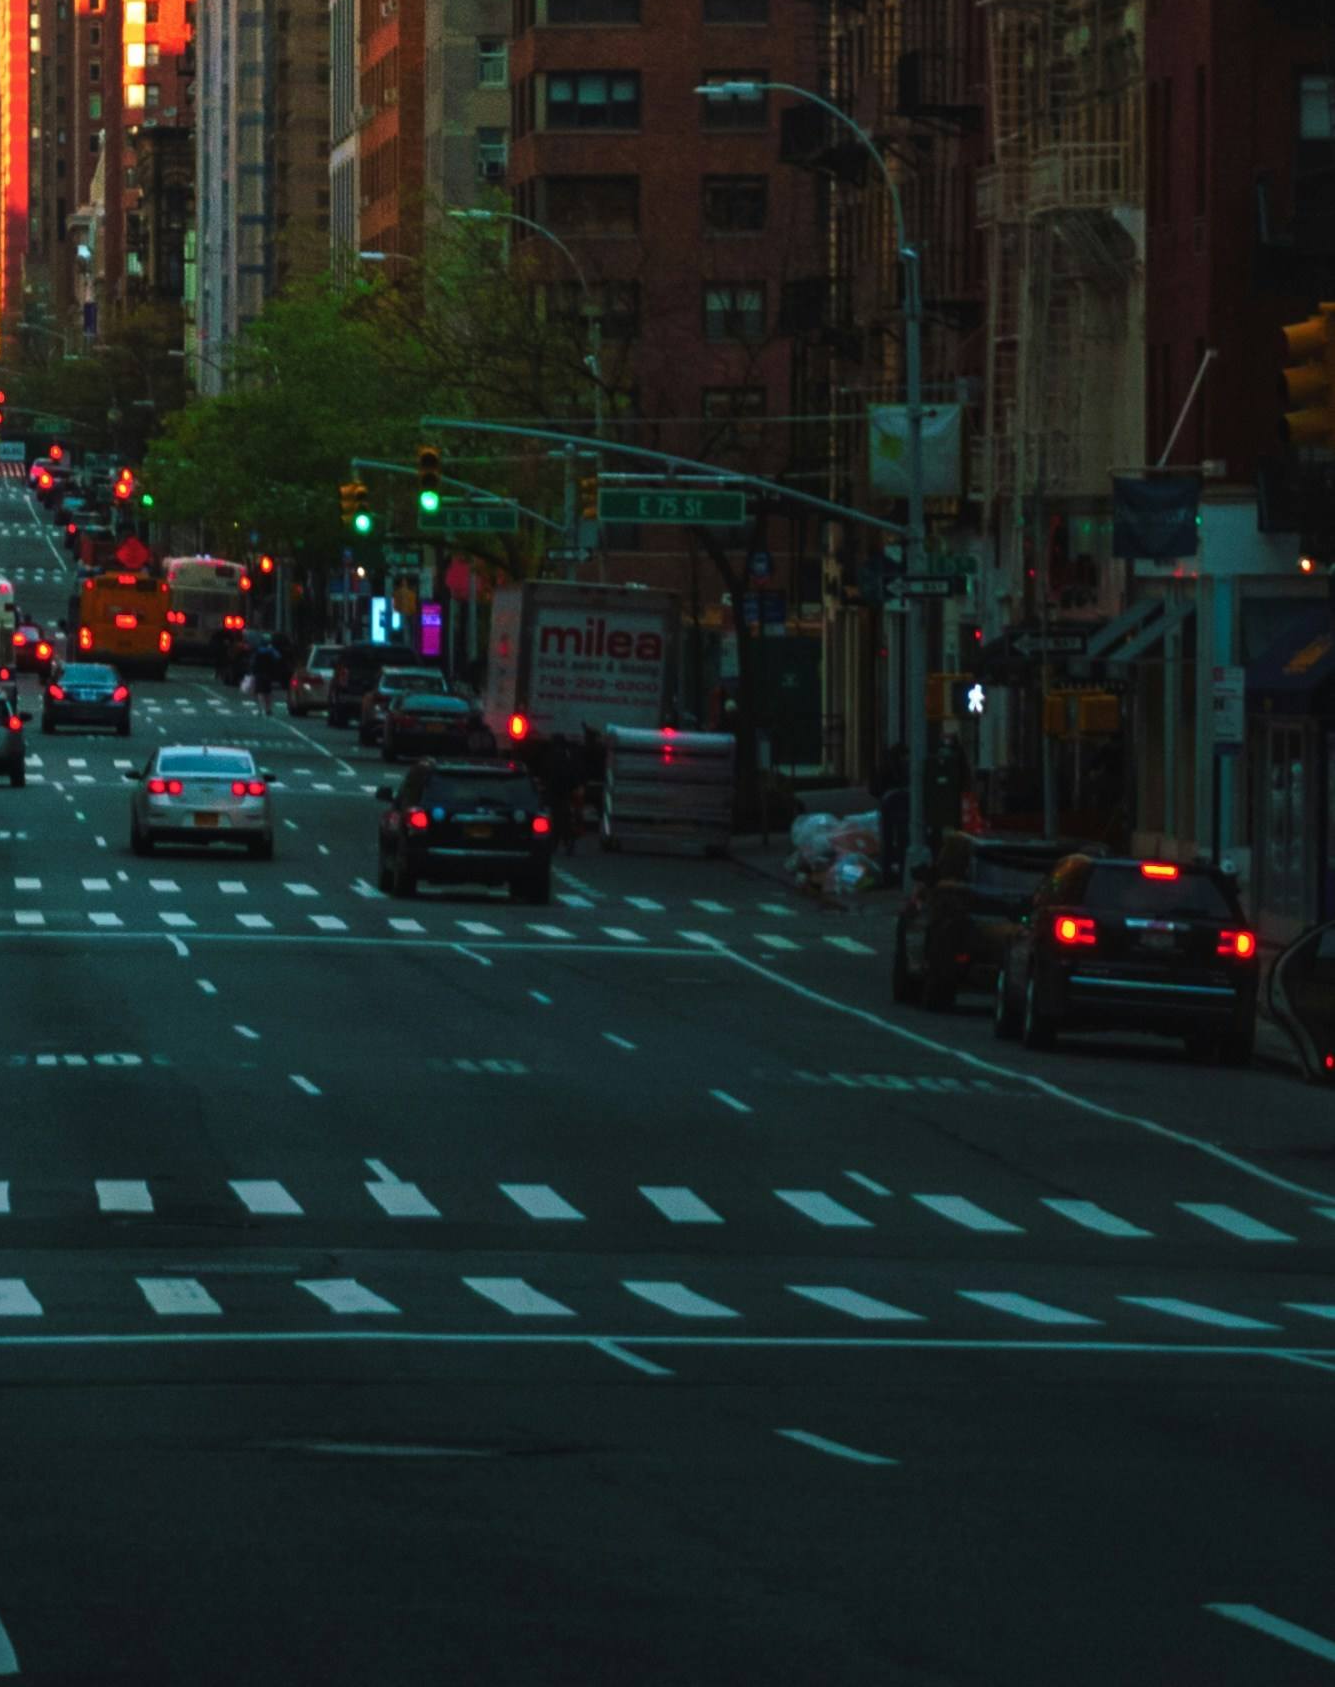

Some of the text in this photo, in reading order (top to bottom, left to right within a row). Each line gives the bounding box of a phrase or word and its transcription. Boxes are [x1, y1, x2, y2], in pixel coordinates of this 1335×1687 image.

[638, 495, 704, 518] E 75 St
[540, 617, 663, 661] milea
